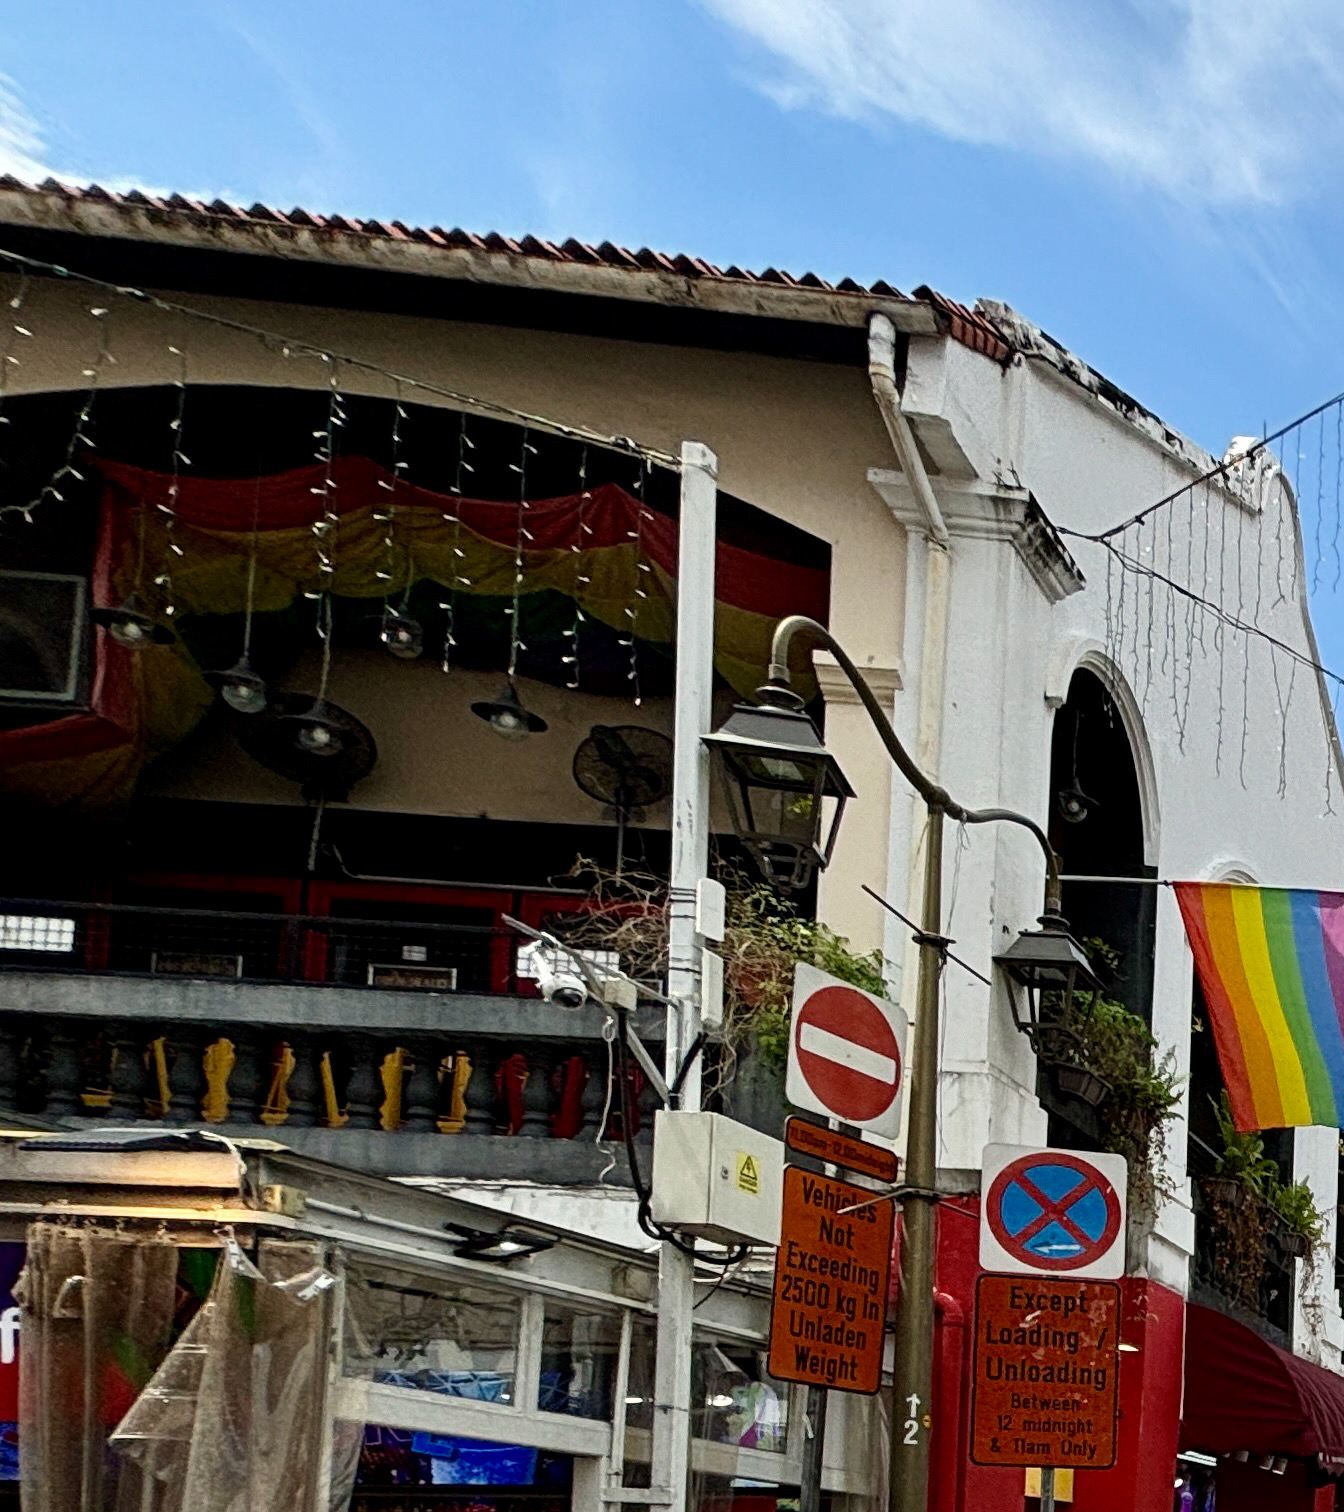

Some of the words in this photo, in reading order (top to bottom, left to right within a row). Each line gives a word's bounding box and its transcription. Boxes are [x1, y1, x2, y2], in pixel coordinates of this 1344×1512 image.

[802, 1176, 878, 1224] Vehicles
[820, 1215, 855, 1250] Not
[786, 1240, 879, 1295] Exceeding
[781, 1274, 830, 1310] 2500
[836, 1287, 856, 1322] kg
[1009, 1285, 1089, 1318] Except
[789, 1310, 867, 1350] Unladen
[986, 1320, 1080, 1355] Loading
[794, 1344, 858, 1384] Weight
[986, 1357, 1107, 1392] Unloading
[1011, 1393, 1082, 1412] Between
[903, 1419, 919, 1445] 2
[997, 1415, 1013, 1431] 12
[1023, 1418, 1093, 1437] midnight
[990, 1438, 1001, 1452] &
[1061, 1439, 1097, 1460] Only
